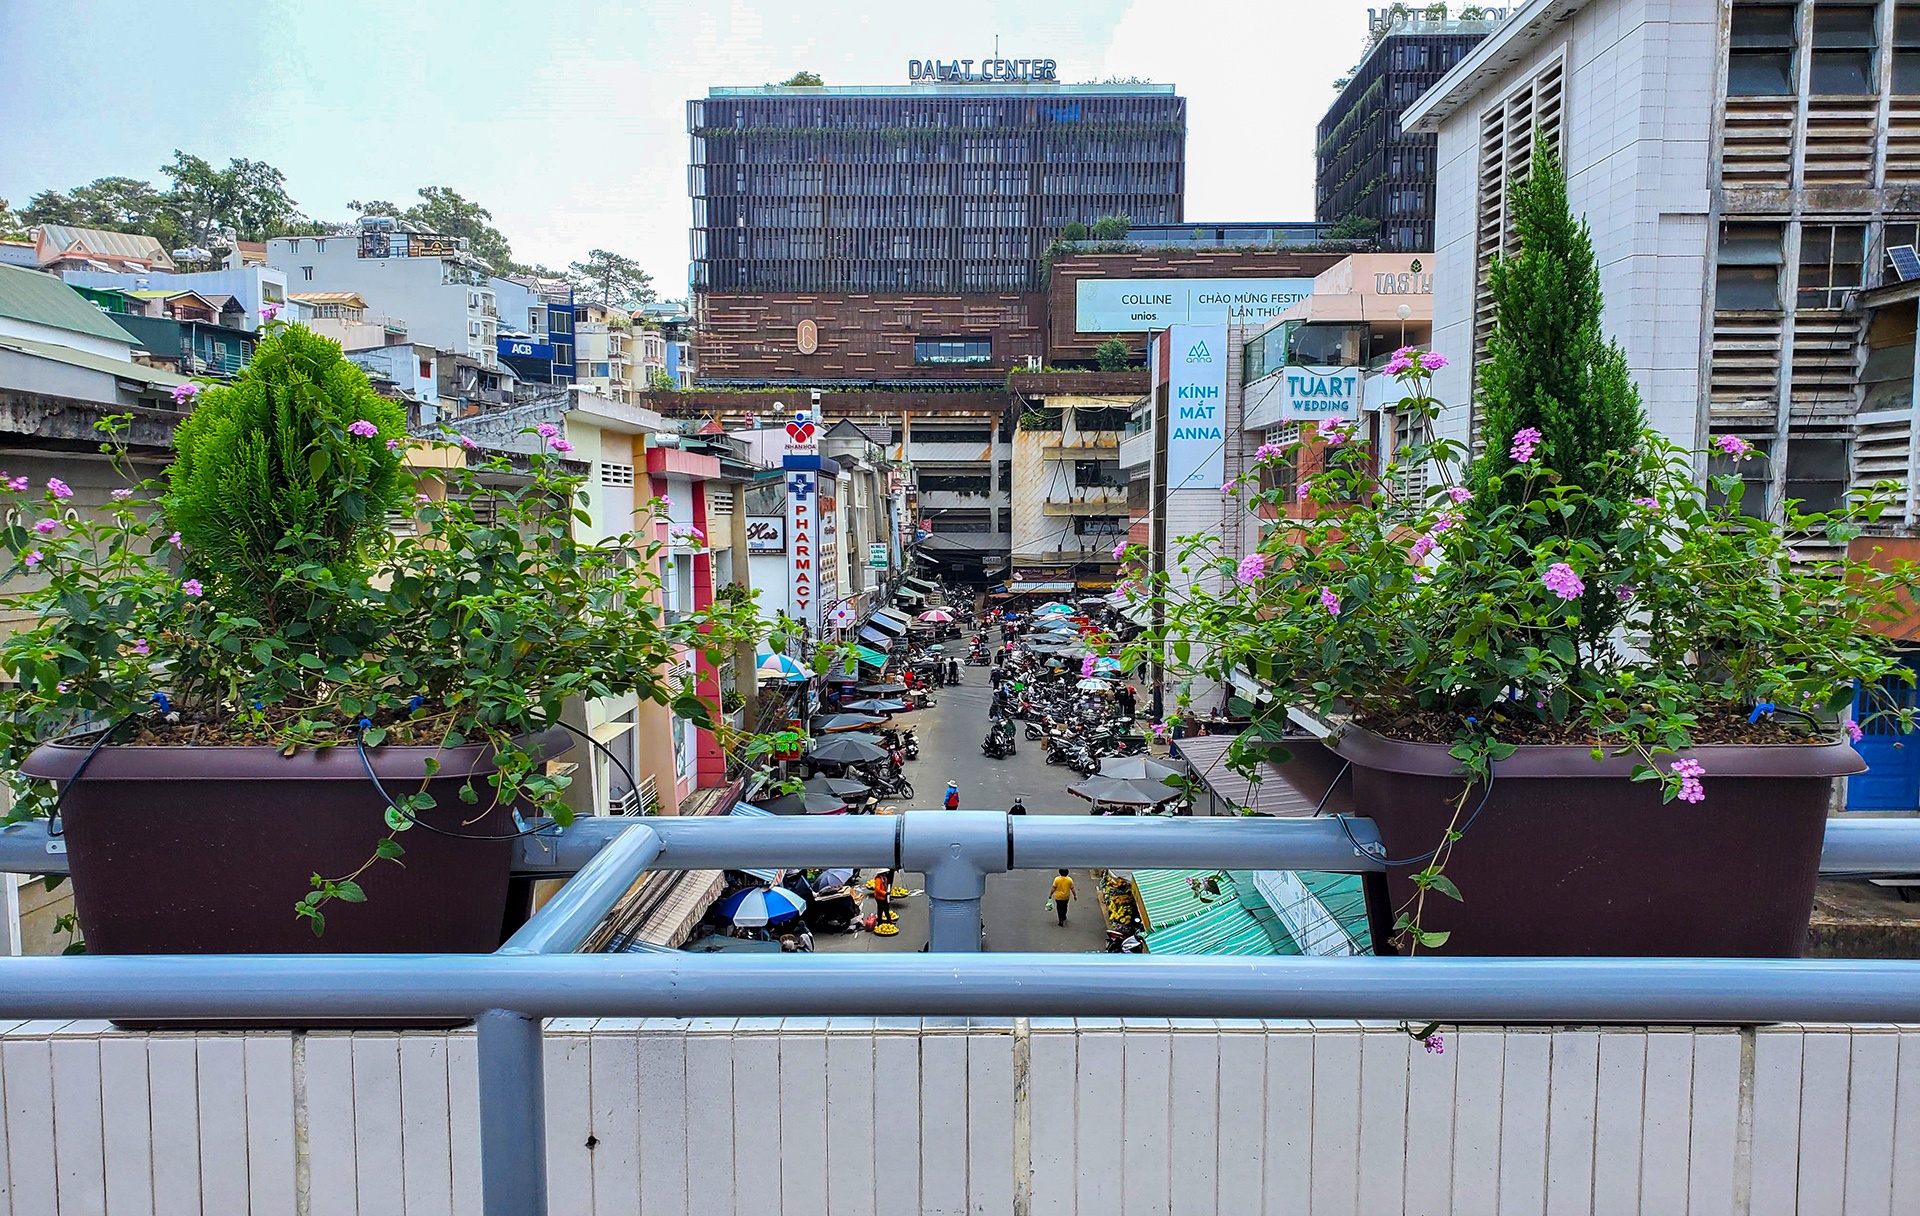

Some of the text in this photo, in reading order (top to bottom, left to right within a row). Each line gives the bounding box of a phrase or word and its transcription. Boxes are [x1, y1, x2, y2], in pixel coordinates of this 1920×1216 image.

[909, 59, 1057, 80] DALAT CENTER
[1121, 294, 1172, 305] COLLINE
[1198, 292, 1231, 304] CHÀO
[1234, 292, 1268, 304] MỪNG
[511, 343, 533, 355] ACB
[1178, 383, 1219, 399] KÍNH
[1287, 376, 1356, 397] TUART
[1180, 400, 1216, 419] MẮT
[1293, 400, 1349, 411] WEDDING
[1173, 427, 1222, 440] ANNA
[795, 505, 811, 610] PHARMACY
